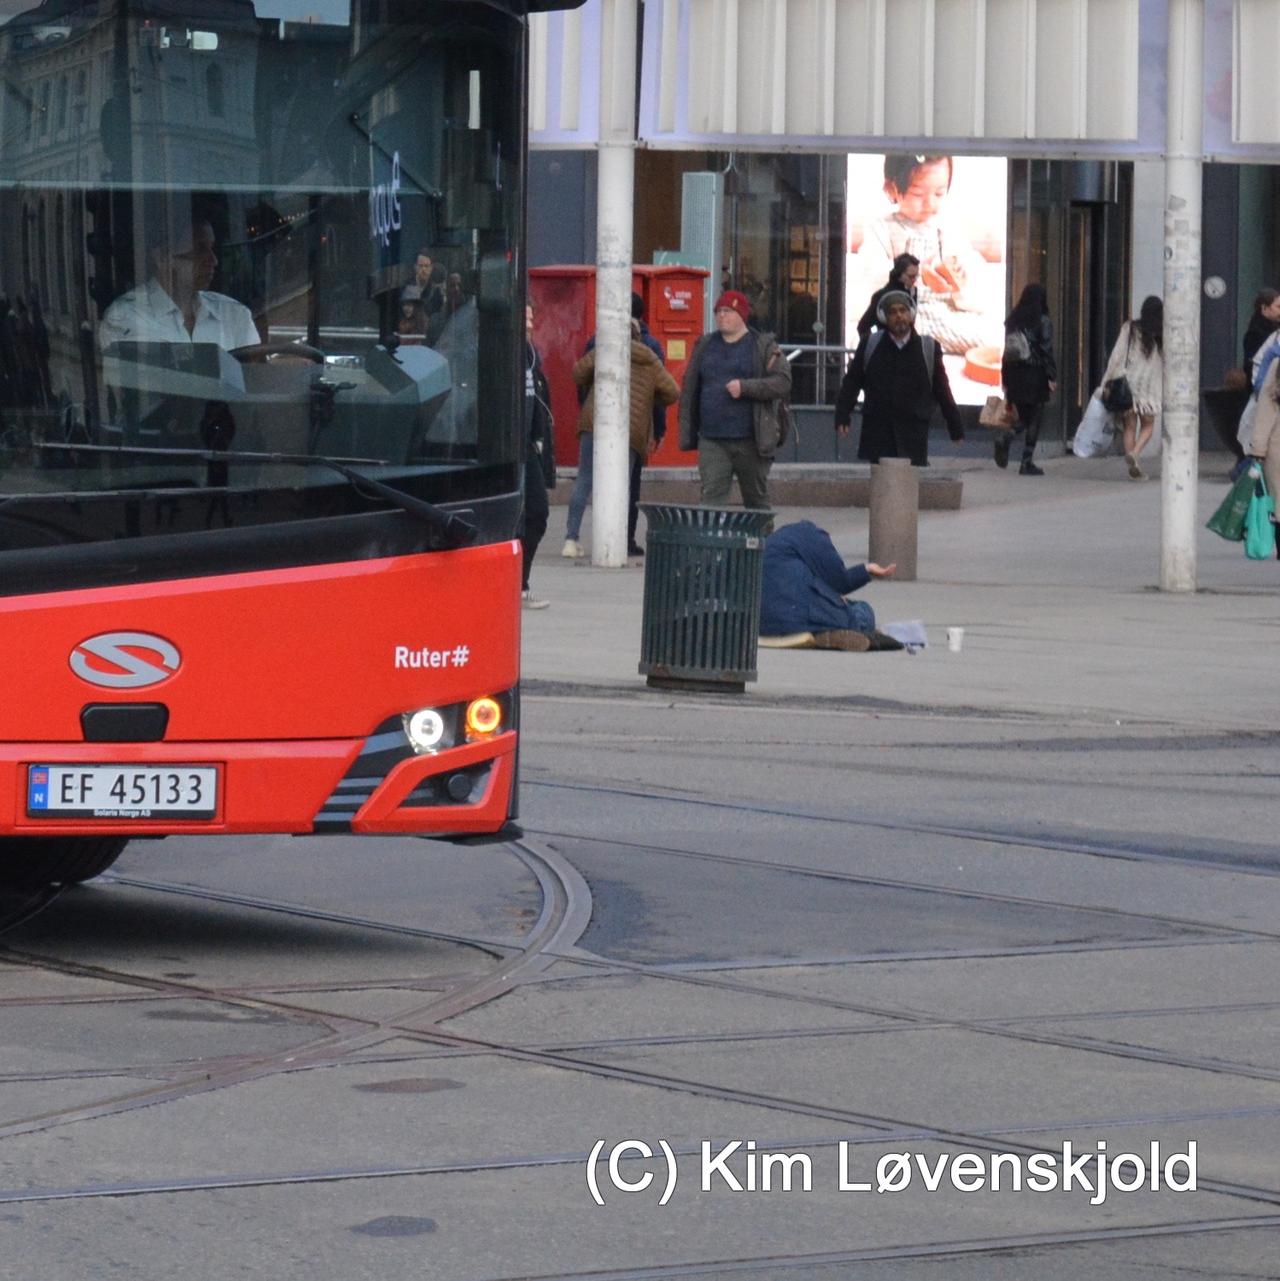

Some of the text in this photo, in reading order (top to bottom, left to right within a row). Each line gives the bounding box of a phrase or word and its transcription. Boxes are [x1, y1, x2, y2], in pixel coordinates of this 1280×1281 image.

[394, 645, 470, 668] Ruter#
[60, 773, 203, 804] EF 45133
[34, 792, 44, 803] N
[93, 808, 151, 819] Solaris Norge AS
